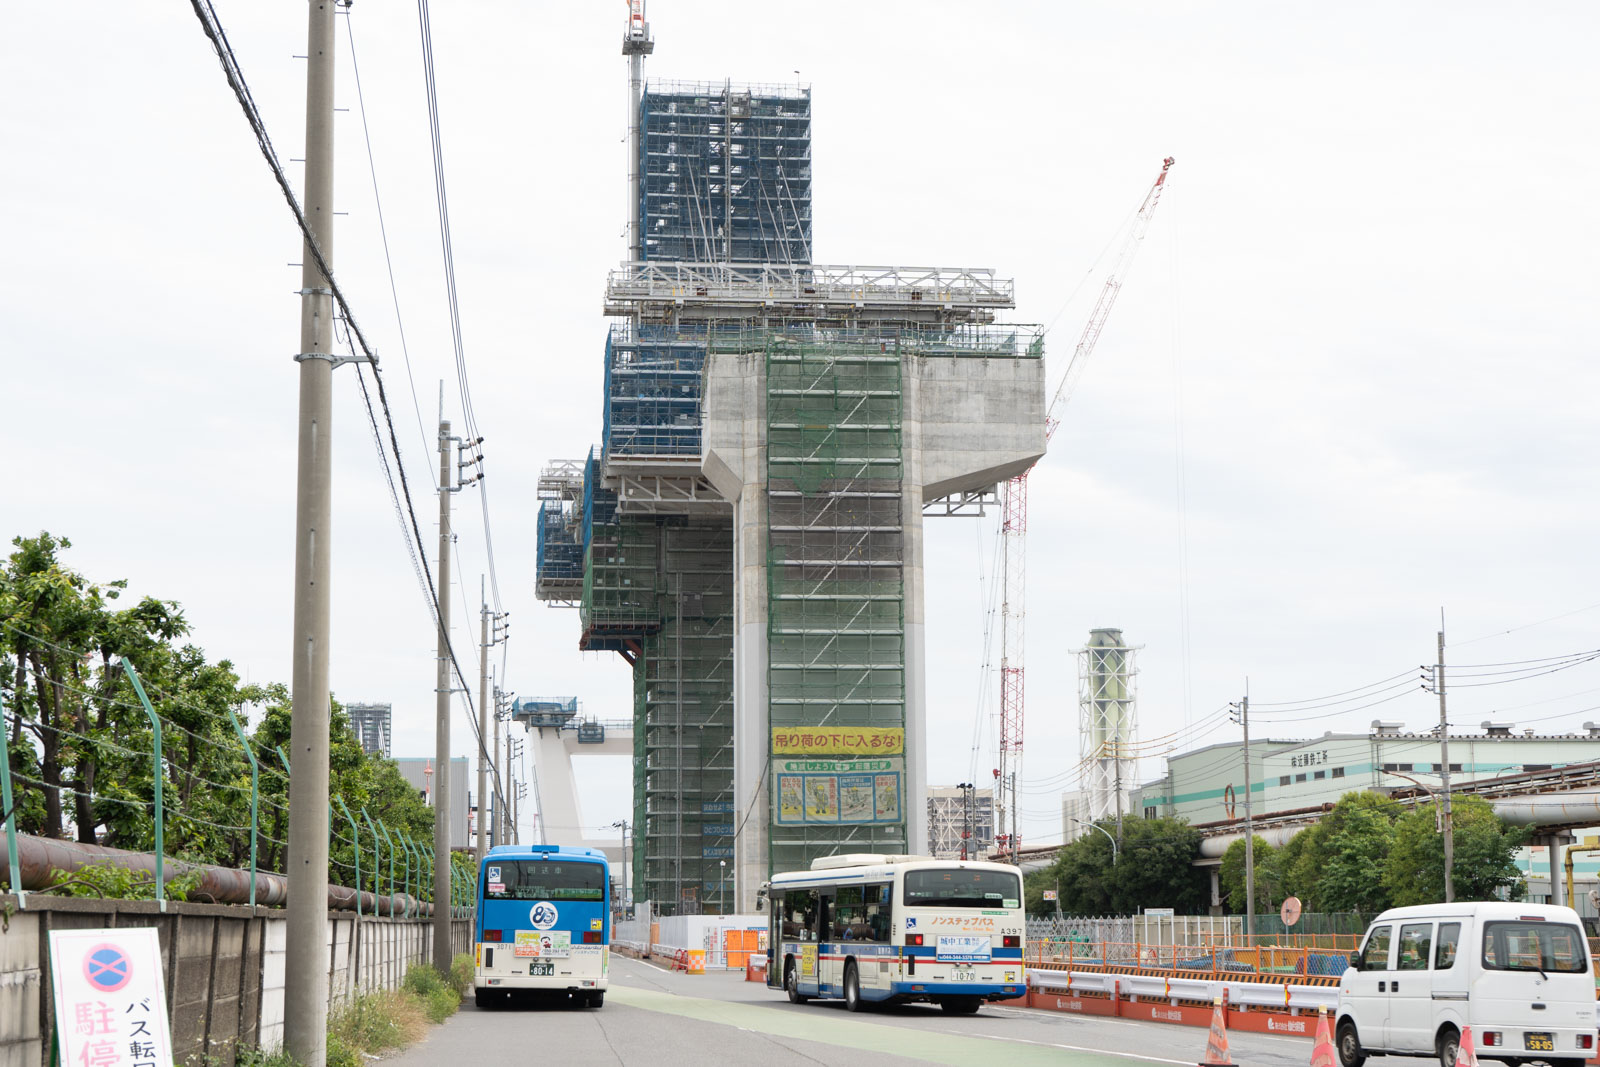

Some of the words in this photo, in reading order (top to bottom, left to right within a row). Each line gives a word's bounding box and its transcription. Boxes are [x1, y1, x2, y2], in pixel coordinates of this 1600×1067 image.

[931, 916, 995, 926] ノンステップバス
[956, 972, 975, 981] 10-70
[125, 997, 156, 1067] バス転
